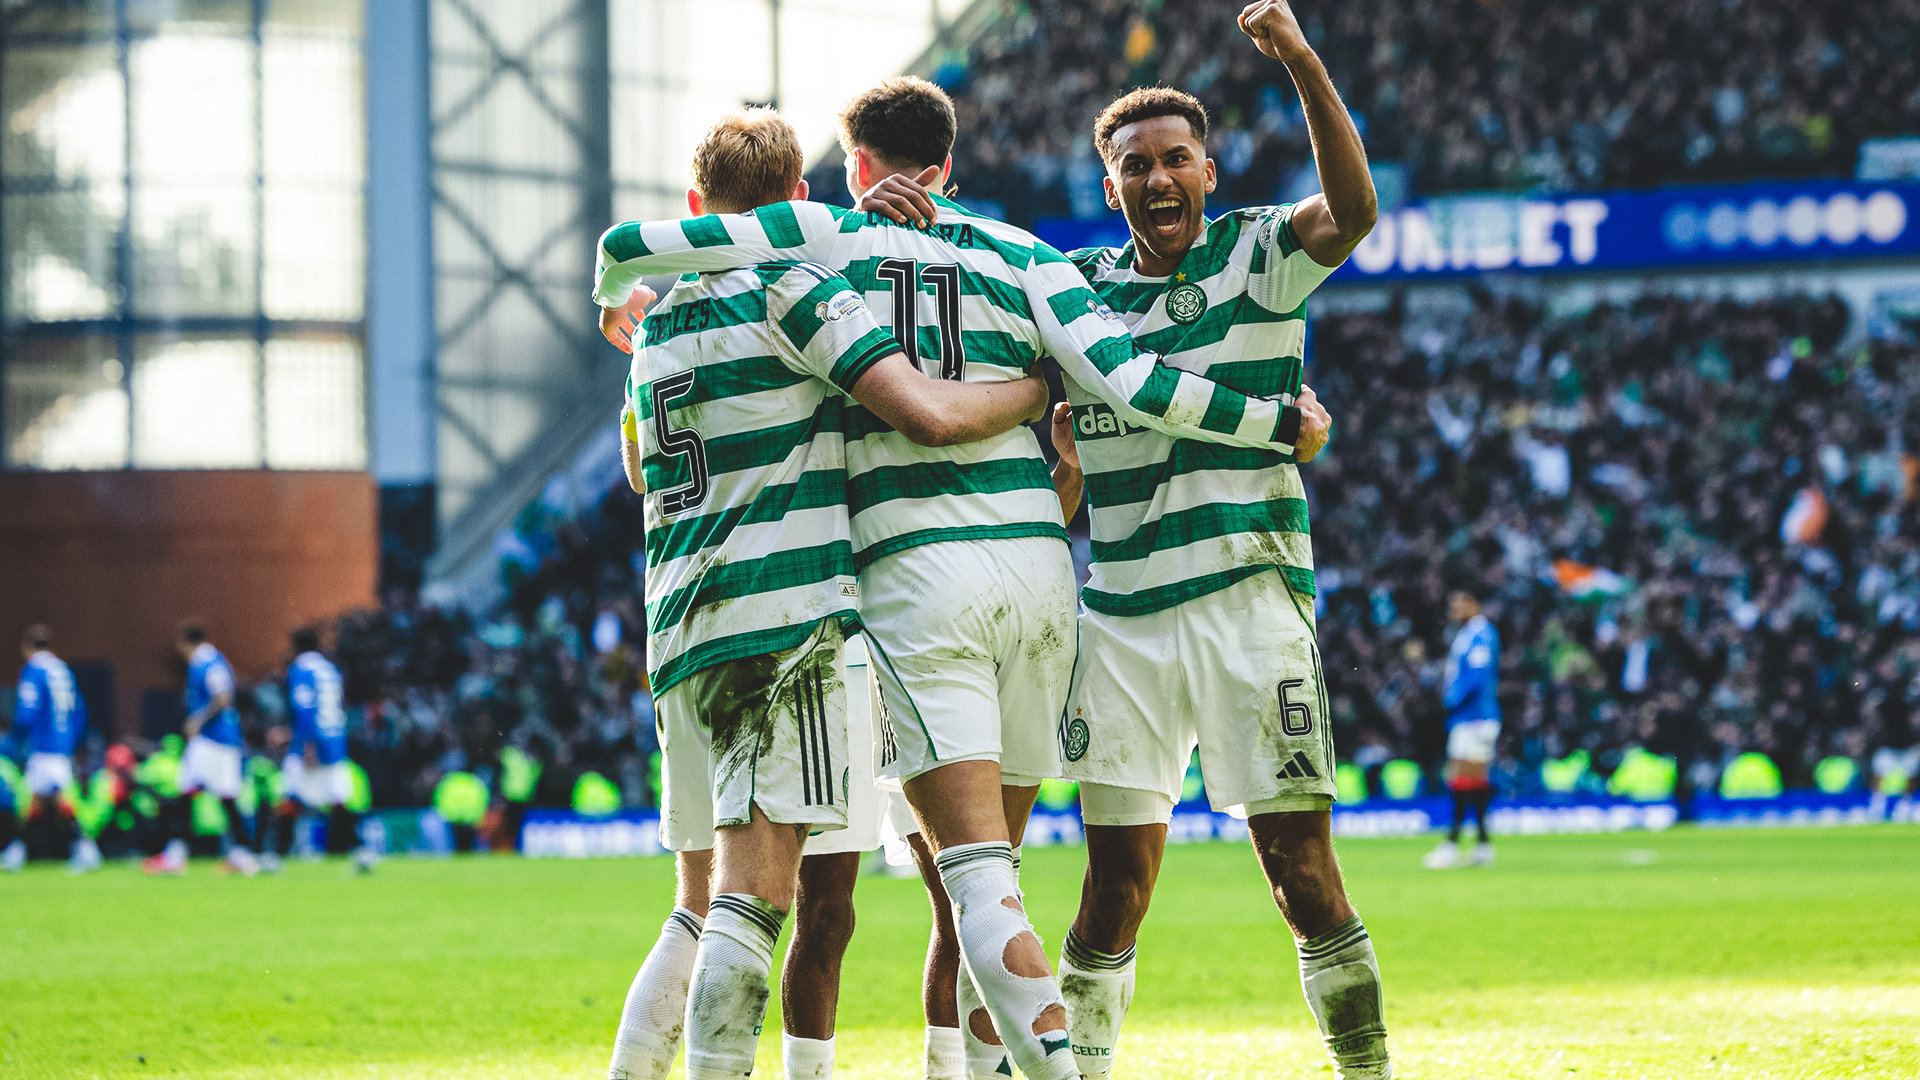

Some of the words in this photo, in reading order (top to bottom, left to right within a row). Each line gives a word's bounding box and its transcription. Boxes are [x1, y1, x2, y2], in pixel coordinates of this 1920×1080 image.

[1349, 198, 1608, 274] UNIBET
[876, 258, 965, 382] 11
[651, 368, 709, 518] 5
[1277, 678, 1314, 738] 6
[1072, 1044, 1111, 1056] CELTIC
